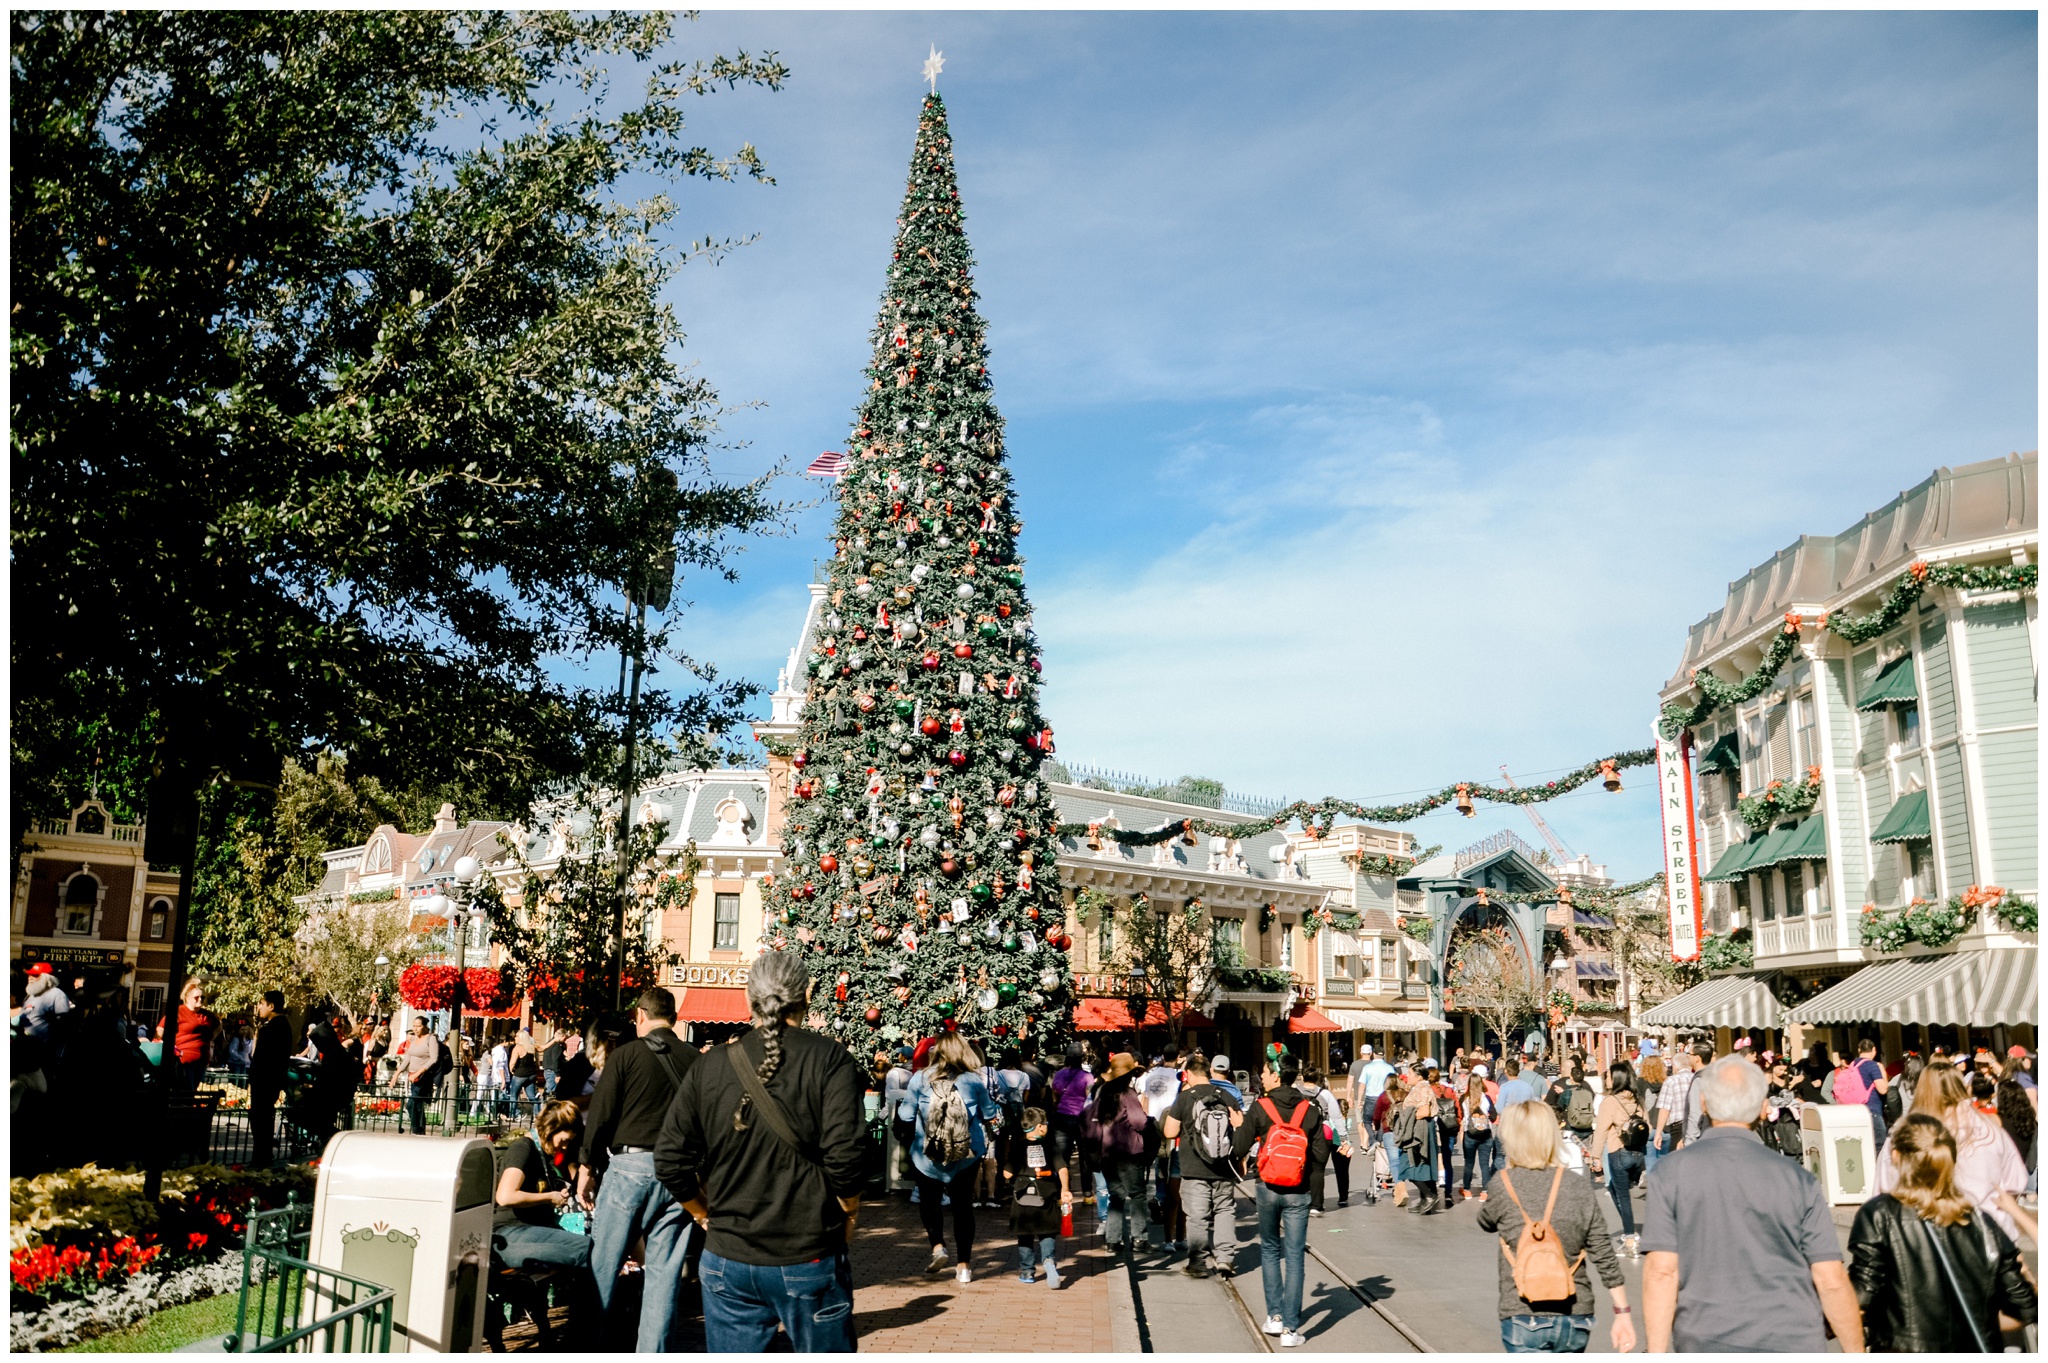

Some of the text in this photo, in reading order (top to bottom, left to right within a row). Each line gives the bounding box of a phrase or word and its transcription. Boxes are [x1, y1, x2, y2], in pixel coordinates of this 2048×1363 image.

[1664, 751, 1688, 915] MAIN STREET
[1675, 924, 1694, 939] HOTEL
[43, 953, 104, 963] FIRE DEPT
[672, 966, 749, 984] BOOKS
[1327, 983, 1354, 993] SOUVENIRS
